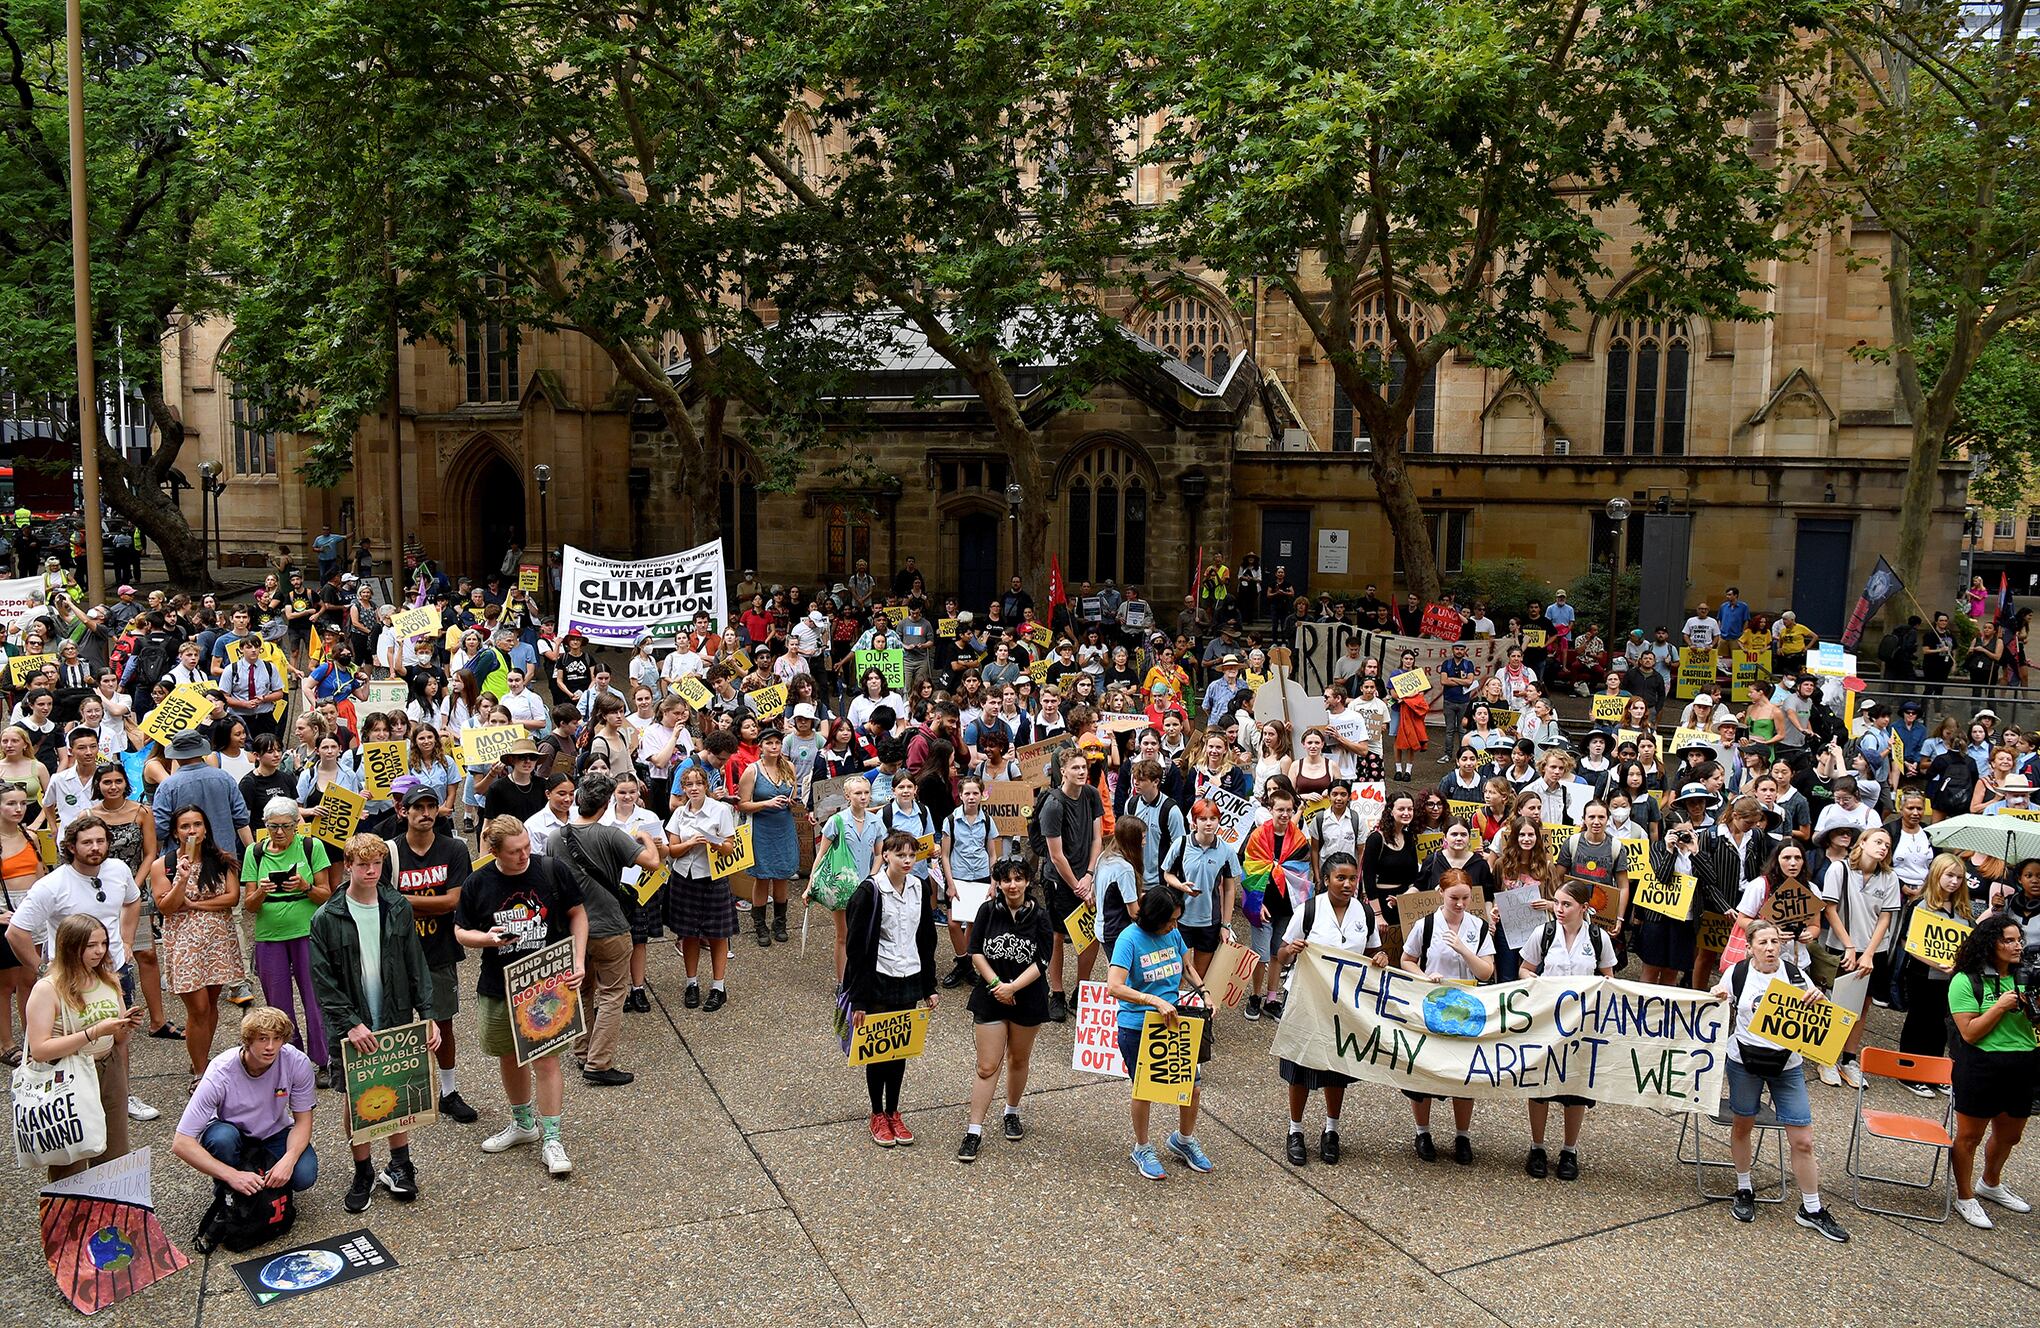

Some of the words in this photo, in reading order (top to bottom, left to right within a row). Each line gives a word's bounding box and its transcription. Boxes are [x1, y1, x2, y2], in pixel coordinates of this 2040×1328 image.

[574, 556, 621, 570] Capitalism
[691, 549, 719, 561] planet
[610, 569, 632, 579] WE
[635, 566, 672, 578] NEED
[674, 564, 685, 575] A
[579, 571, 713, 602] CLIMATE
[395, 609, 425, 626] CLIMATE
[576, 595, 713, 619] REVOLUTION
[400, 617, 431, 636] NOW
[402, 613, 428, 628] ACTION
[574, 624, 637, 638] SOCIALIST
[654, 623, 713, 637] ALLIANE
[12, 656, 46, 669] CLIMATE
[865, 652, 889, 662] OUR
[1746, 652, 1758, 662] NO
[1682, 669, 1712, 679] GASFIELDS
[676, 684, 702, 702] NOW
[1400, 678, 1422, 695] NOW
[149, 696, 179, 735] CLIMATE
[160, 698, 186, 733] ACTION
[164, 701, 198, 742] NOW
[1596, 708, 1624, 717] NOW
[475, 730, 519, 750] NOW
[1677, 733, 1709, 742] CLIMATE
[367, 748, 391, 789] NOW
[328, 797, 341, 834] ACTION
[333, 800, 353, 841] NOW
[1417, 839, 1443, 851] CLIM
[714, 845, 744, 875] NOW
[1641, 889, 1680, 906] NOW
[1648, 881, 1682, 892] ACTION
[1774, 887, 1807, 901] WELL
[415, 920, 437, 937] NO
[1703, 934, 1730, 947] NO
[509, 957, 542, 978] FUND
[545, 943, 571, 962] OUR
[509, 956, 572, 992] FUTURE
[512, 982, 542, 1007] NOT
[544, 968, 573, 991] GAS
[1321, 954, 1413, 1024] THE
[1499, 989, 1532, 1033] IS
[1554, 988, 1722, 1043] CHANGING
[1768, 992, 1833, 1017] CLIMATE
[857, 1012, 911, 1036] CLIMATE
[1773, 1006, 1832, 1028] ACTION
[865, 1021, 911, 1044] ACTION
[1077, 1026, 1119, 1049] WE'RE
[1760, 1014, 1829, 1047] NOW
[527, 1027, 576, 1059] greenleft.org.au
[858, 1030, 912, 1061] NOW
[1148, 1022, 1169, 1085] NOW
[1178, 1021, 1192, 1083] CLIMATE
[347, 1044, 427, 1073] RENEWABLES
[1081, 1049, 1115, 1071] OUT
[1167, 1029, 1181, 1085] ACTION
[1333, 1014, 1427, 1075] WHY
[1464, 1036, 1610, 1089] AREN'T
[1631, 1047, 1714, 1103] WE?
[357, 1068, 377, 1083] BY
[381, 1057, 419, 1076] 2030
[370, 1120, 398, 1137] green
[398, 1115, 416, 1127] left
[18, 1129, 42, 1153] MY
